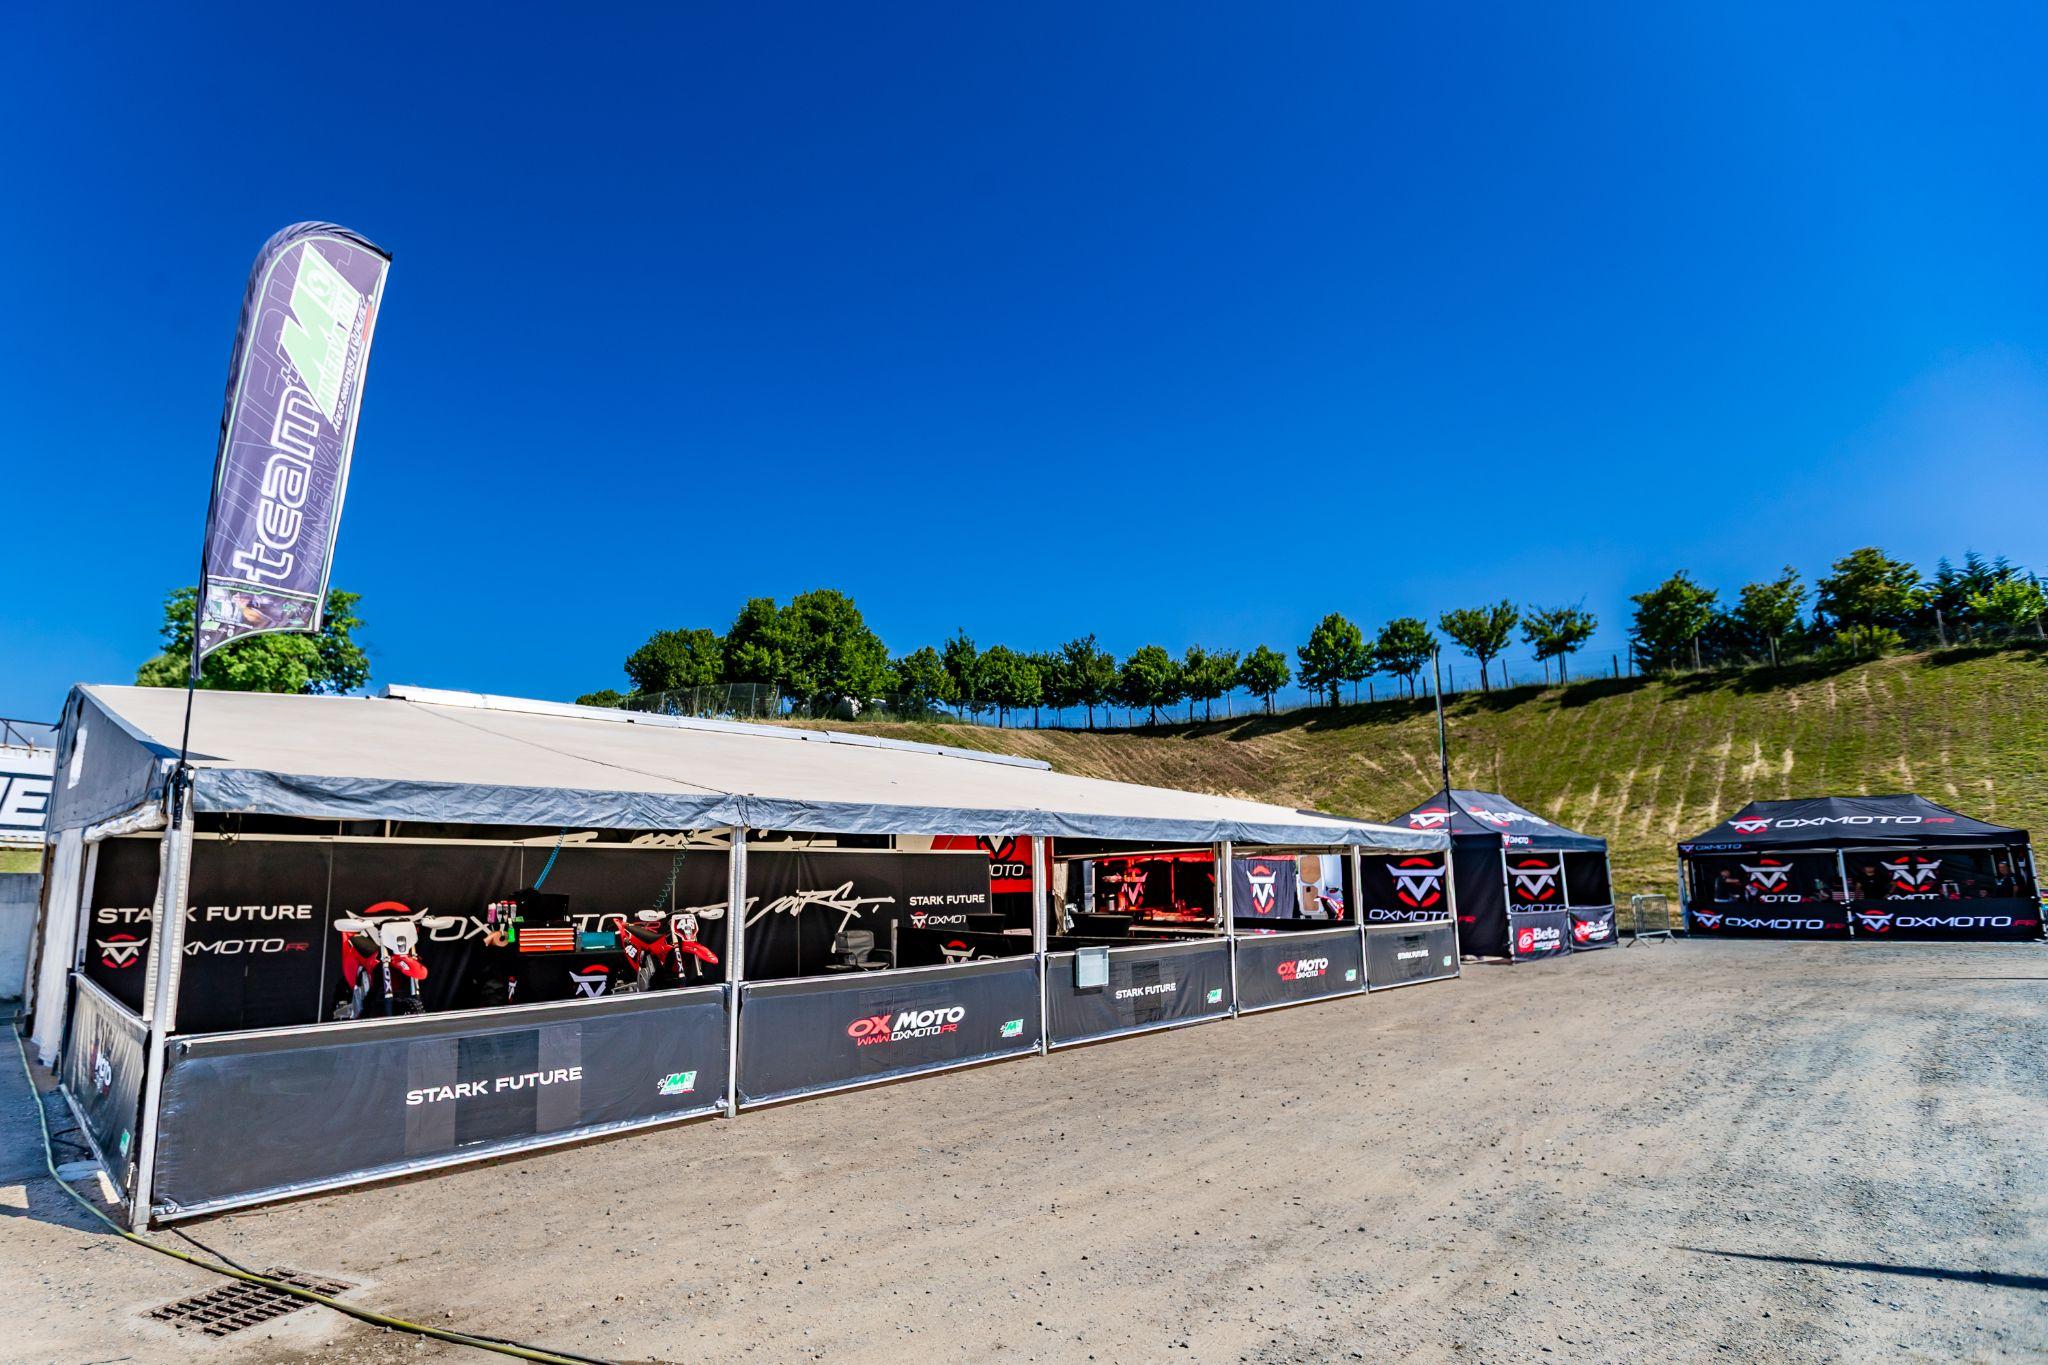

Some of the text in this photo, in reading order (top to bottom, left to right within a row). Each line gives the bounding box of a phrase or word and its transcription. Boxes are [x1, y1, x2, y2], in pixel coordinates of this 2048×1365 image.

[232, 386, 322, 582] team
[909, 894, 985, 906] STARK FUTURE
[97, 905, 313, 924] STAK FUTURE
[1533, 927, 1560, 940] Beta
[1277, 958, 1328, 975] OX MOTO
[1115, 983, 1176, 999] STARK FUTURE
[847, 1006, 965, 1037] OX MOTO
[406, 1066, 583, 1105] STARK FUTURE
